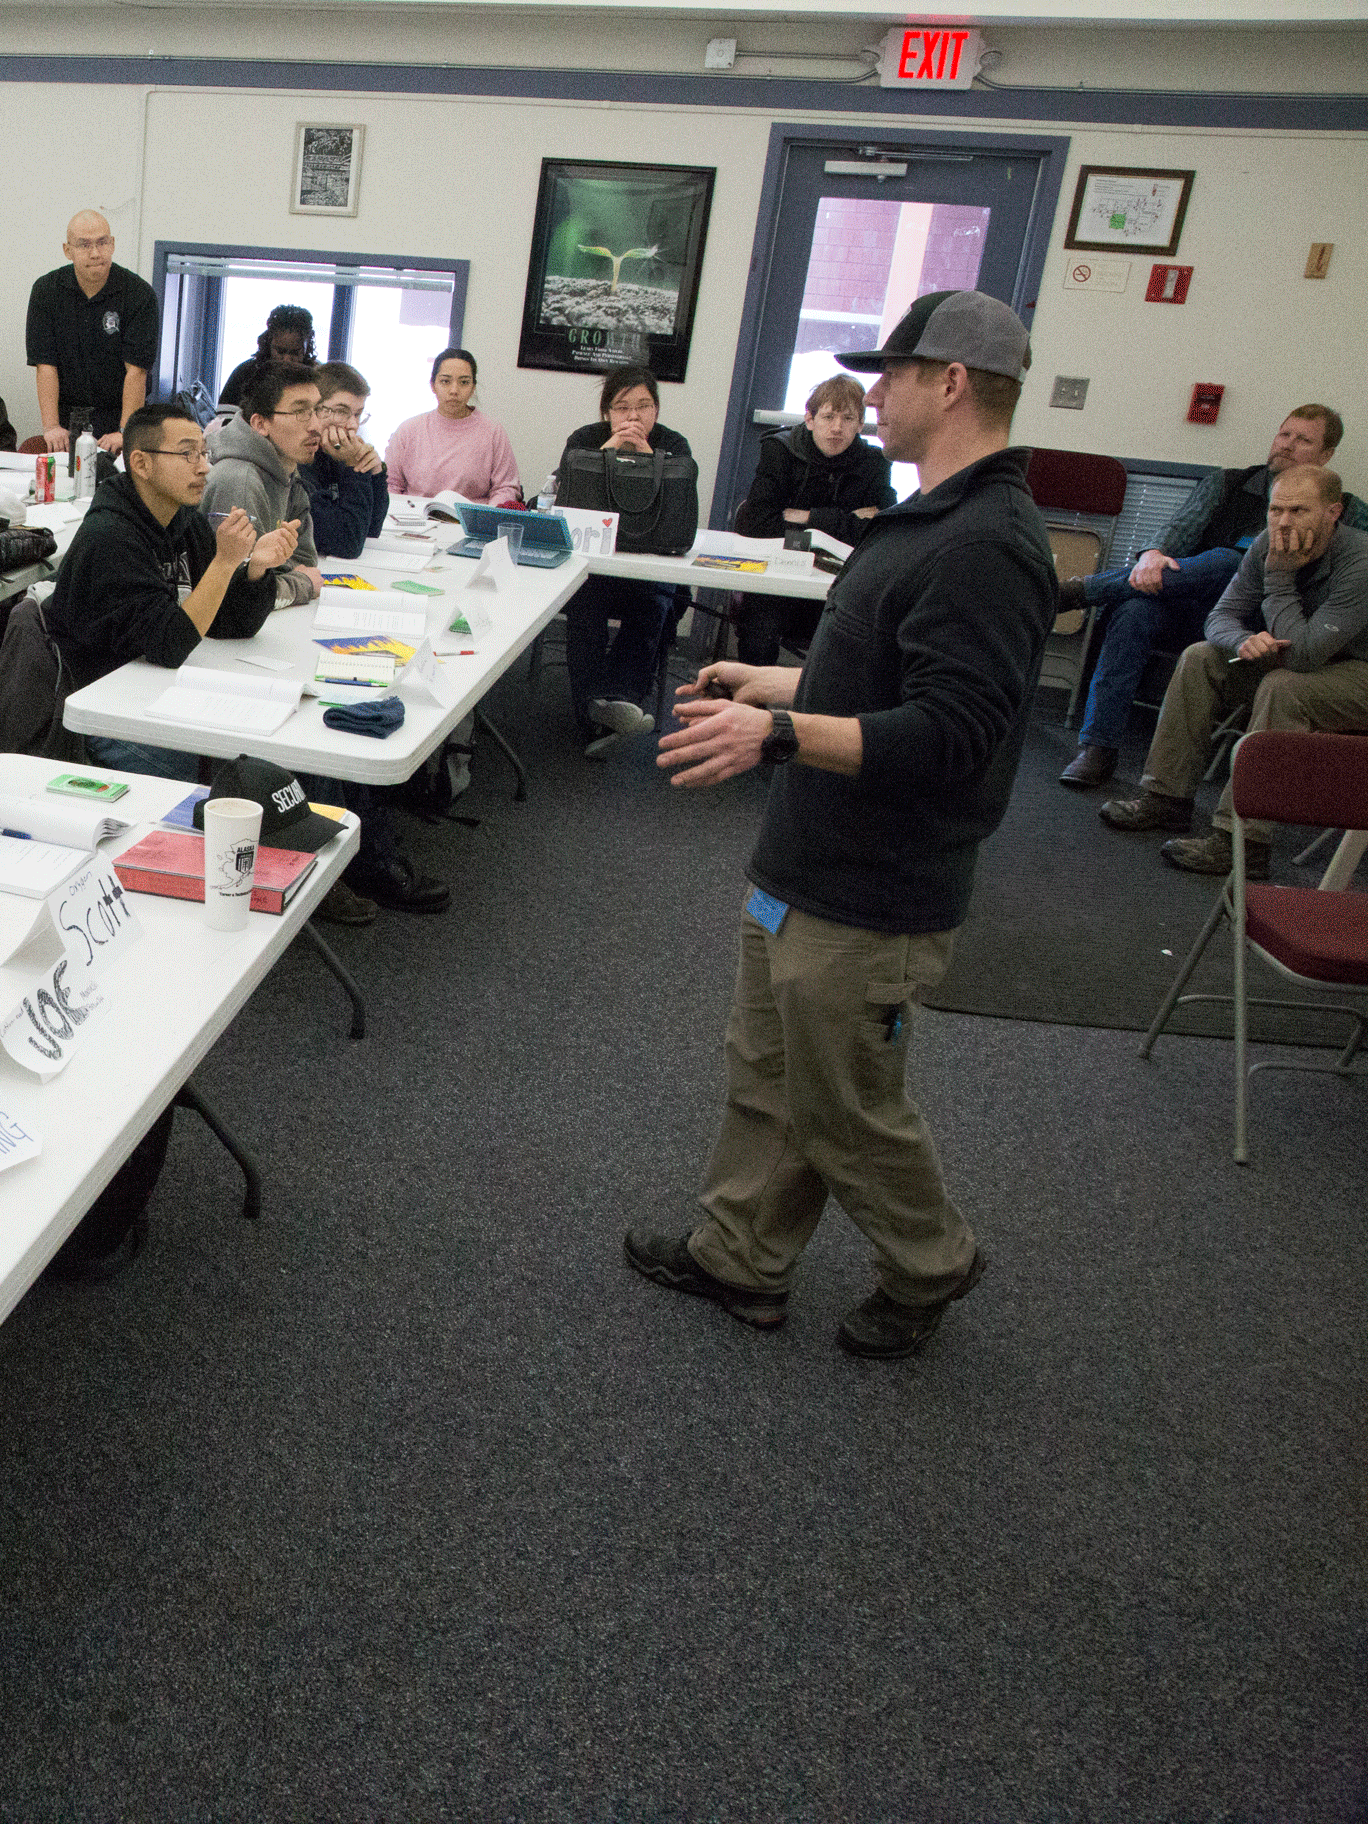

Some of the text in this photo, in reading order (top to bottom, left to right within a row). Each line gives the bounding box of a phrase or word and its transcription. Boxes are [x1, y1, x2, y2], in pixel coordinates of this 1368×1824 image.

[898, 31, 970, 79] EXIT
[59, 874, 131, 968] Scott
[22, 960, 92, 1061] JOE
